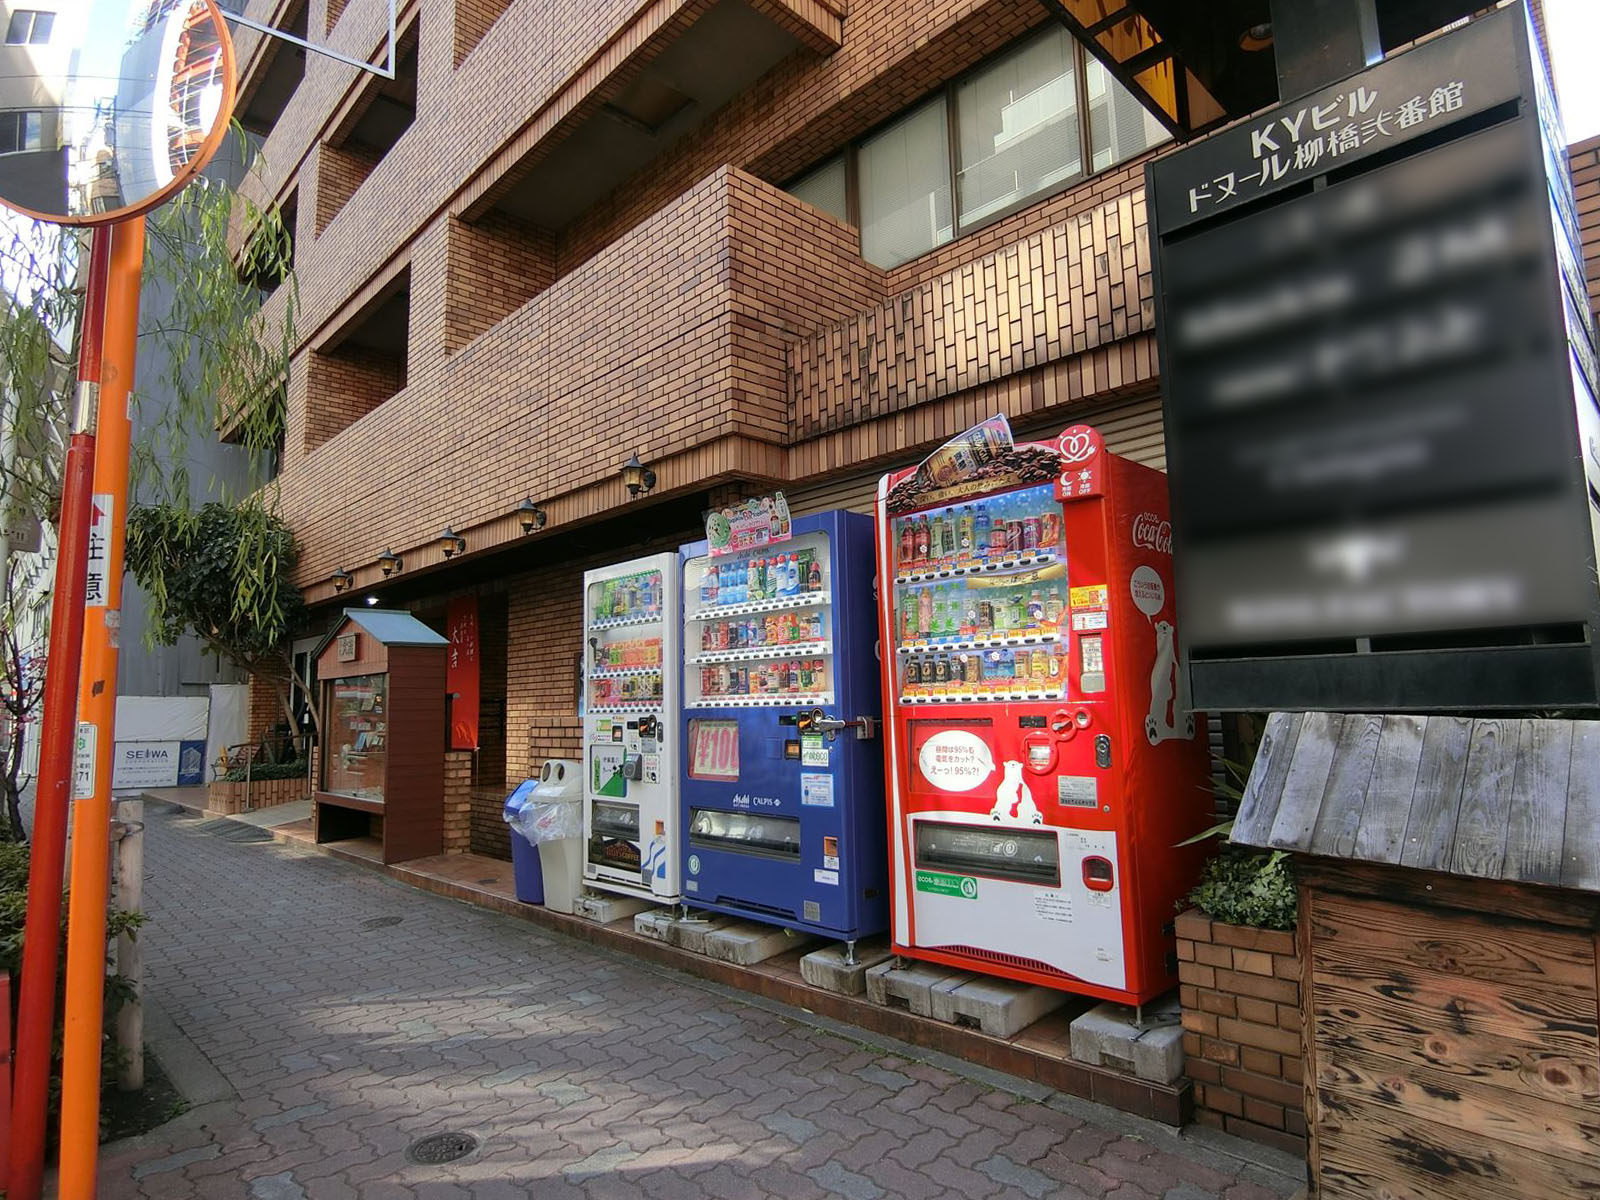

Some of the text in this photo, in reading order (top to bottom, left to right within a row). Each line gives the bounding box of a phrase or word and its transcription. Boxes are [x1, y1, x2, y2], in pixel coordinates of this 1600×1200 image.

[1251, 86, 1378, 159] KYビル
[126, 748, 169, 760] SEIWA
[732, 792, 749, 804] Asahi
[753, 796, 772, 806] CALPIS
